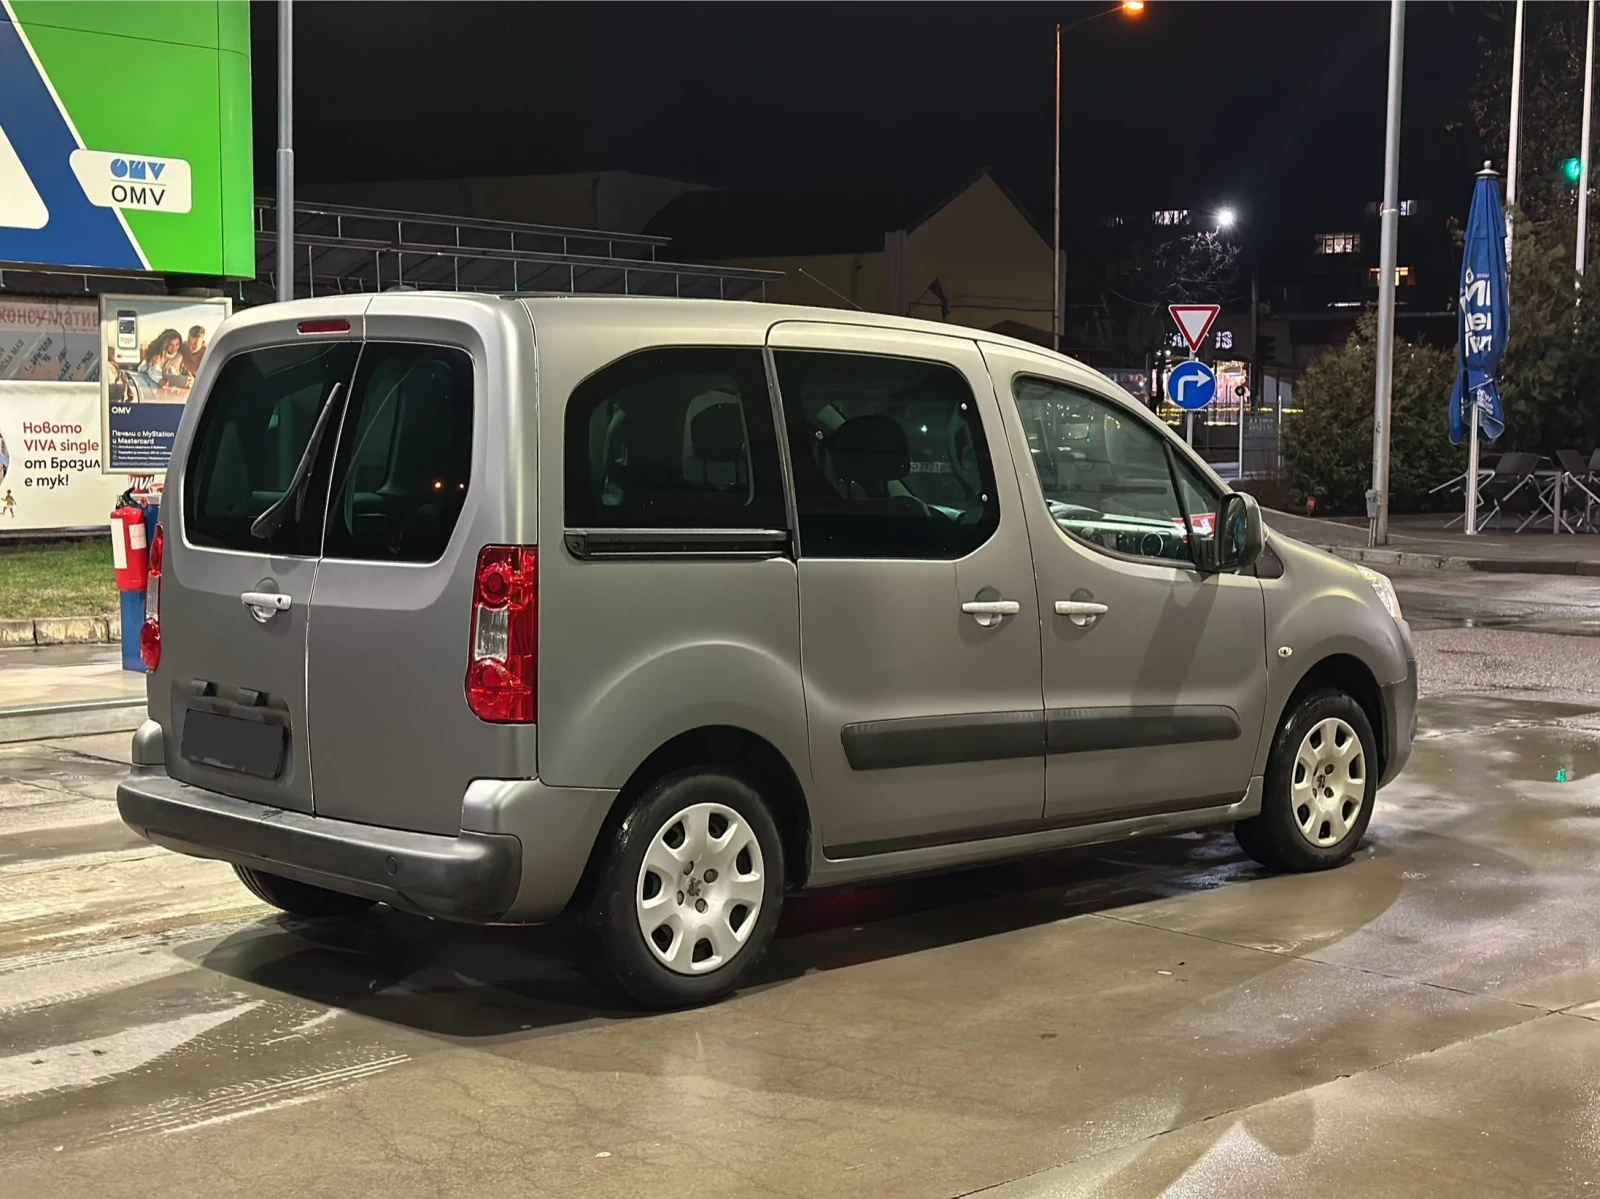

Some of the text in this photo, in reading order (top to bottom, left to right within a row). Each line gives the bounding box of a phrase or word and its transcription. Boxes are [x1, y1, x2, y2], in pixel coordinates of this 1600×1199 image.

[111, 185, 165, 206] OMV
[111, 406, 131, 414] OMV
[23, 421, 82, 434] Новото
[142, 430, 175, 438] MyStation
[24, 439, 99, 454] VIVA single
[24, 459, 47, 469] от
[50, 457, 100, 472] Бразил
[24, 474, 69, 490] е тук!
